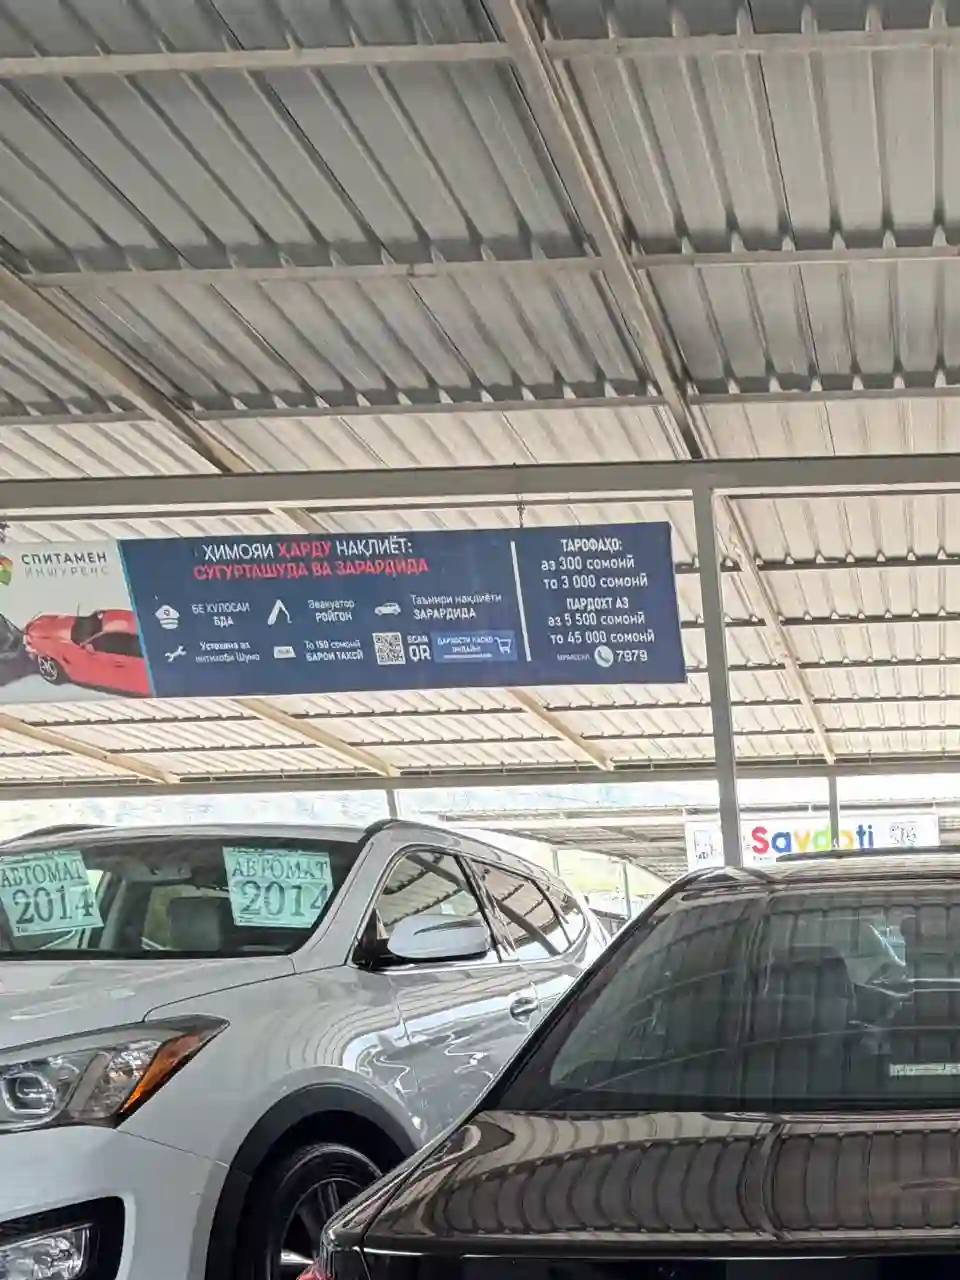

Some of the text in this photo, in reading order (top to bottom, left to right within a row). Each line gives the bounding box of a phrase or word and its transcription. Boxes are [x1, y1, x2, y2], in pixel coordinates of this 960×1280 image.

[202, 536, 413, 562] ҲИМОЯИ ҲАРДУ НАҚЛИЁТ:
[560, 537, 623, 553] ТАРОФАҲО:
[21, 551, 108, 565] СПИТАМЕН
[541, 560, 556, 571] аз
[559, 556, 582, 570] 300
[24, 566, 110, 578] ИНШУРЕНС
[312, 561, 332, 576] ВА
[335, 558, 429, 577] ЗАРАРДИДА
[543, 579, 557, 589] то
[561, 575, 569, 588] 3
[573, 574, 596, 588] 000
[191, 603, 204, 614] БЕ
[566, 596, 629, 611] ПАРДОХТ АЗ
[413, 607, 477, 620] ЗАРАРДИДА
[548, 616, 561, 626] аз
[564, 612, 572, 626] 5
[575, 612, 596, 625] 500
[407, 634, 428, 643] SCAN
[549, 634, 563, 644] то
[567, 631, 581, 644] 45
[586, 630, 606, 643] 000
[409, 645, 432, 662] QR
[12, 885, 94, 924] 2014
[240, 881, 328, 917] 2014
